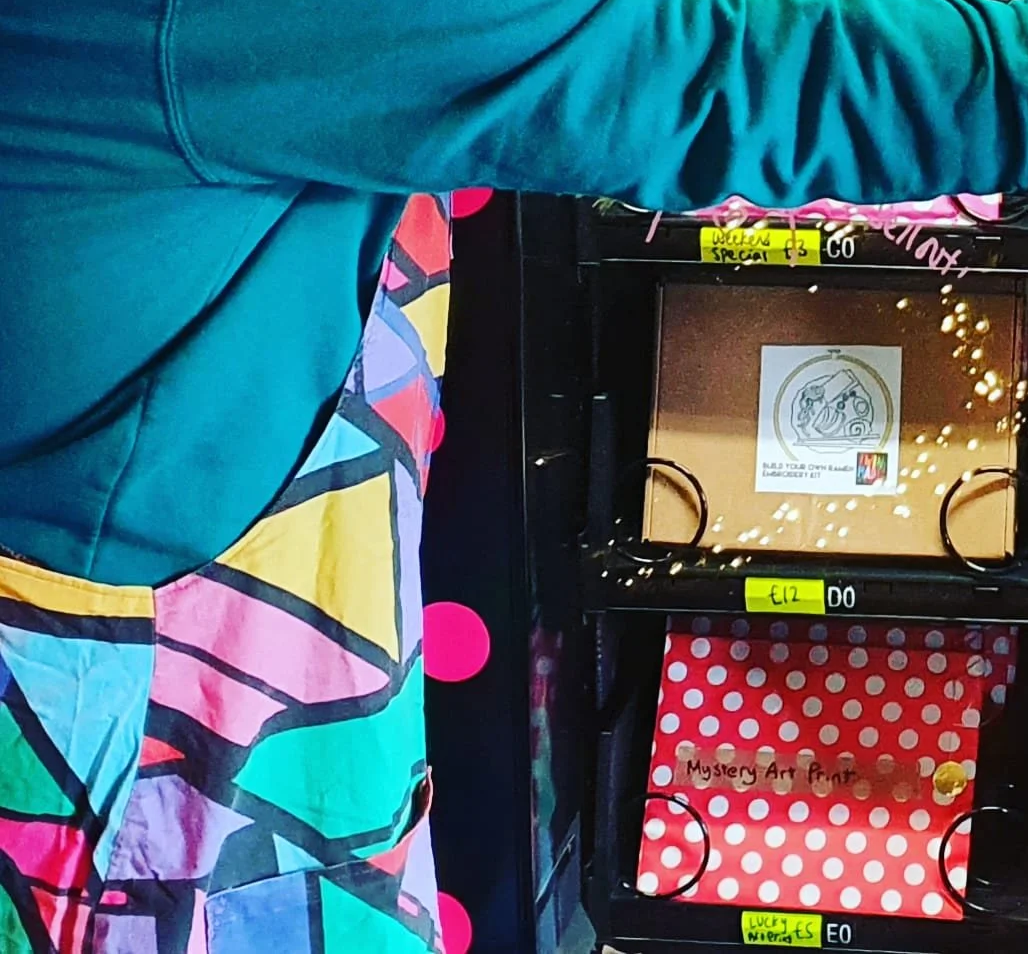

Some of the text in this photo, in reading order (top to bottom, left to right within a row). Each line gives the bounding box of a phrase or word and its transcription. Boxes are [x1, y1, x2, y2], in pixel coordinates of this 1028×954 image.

[786, 463, 807, 471] YOUR
[808, 463, 827, 471] OWN
[687, 760, 858, 785] Mystery Art Print
